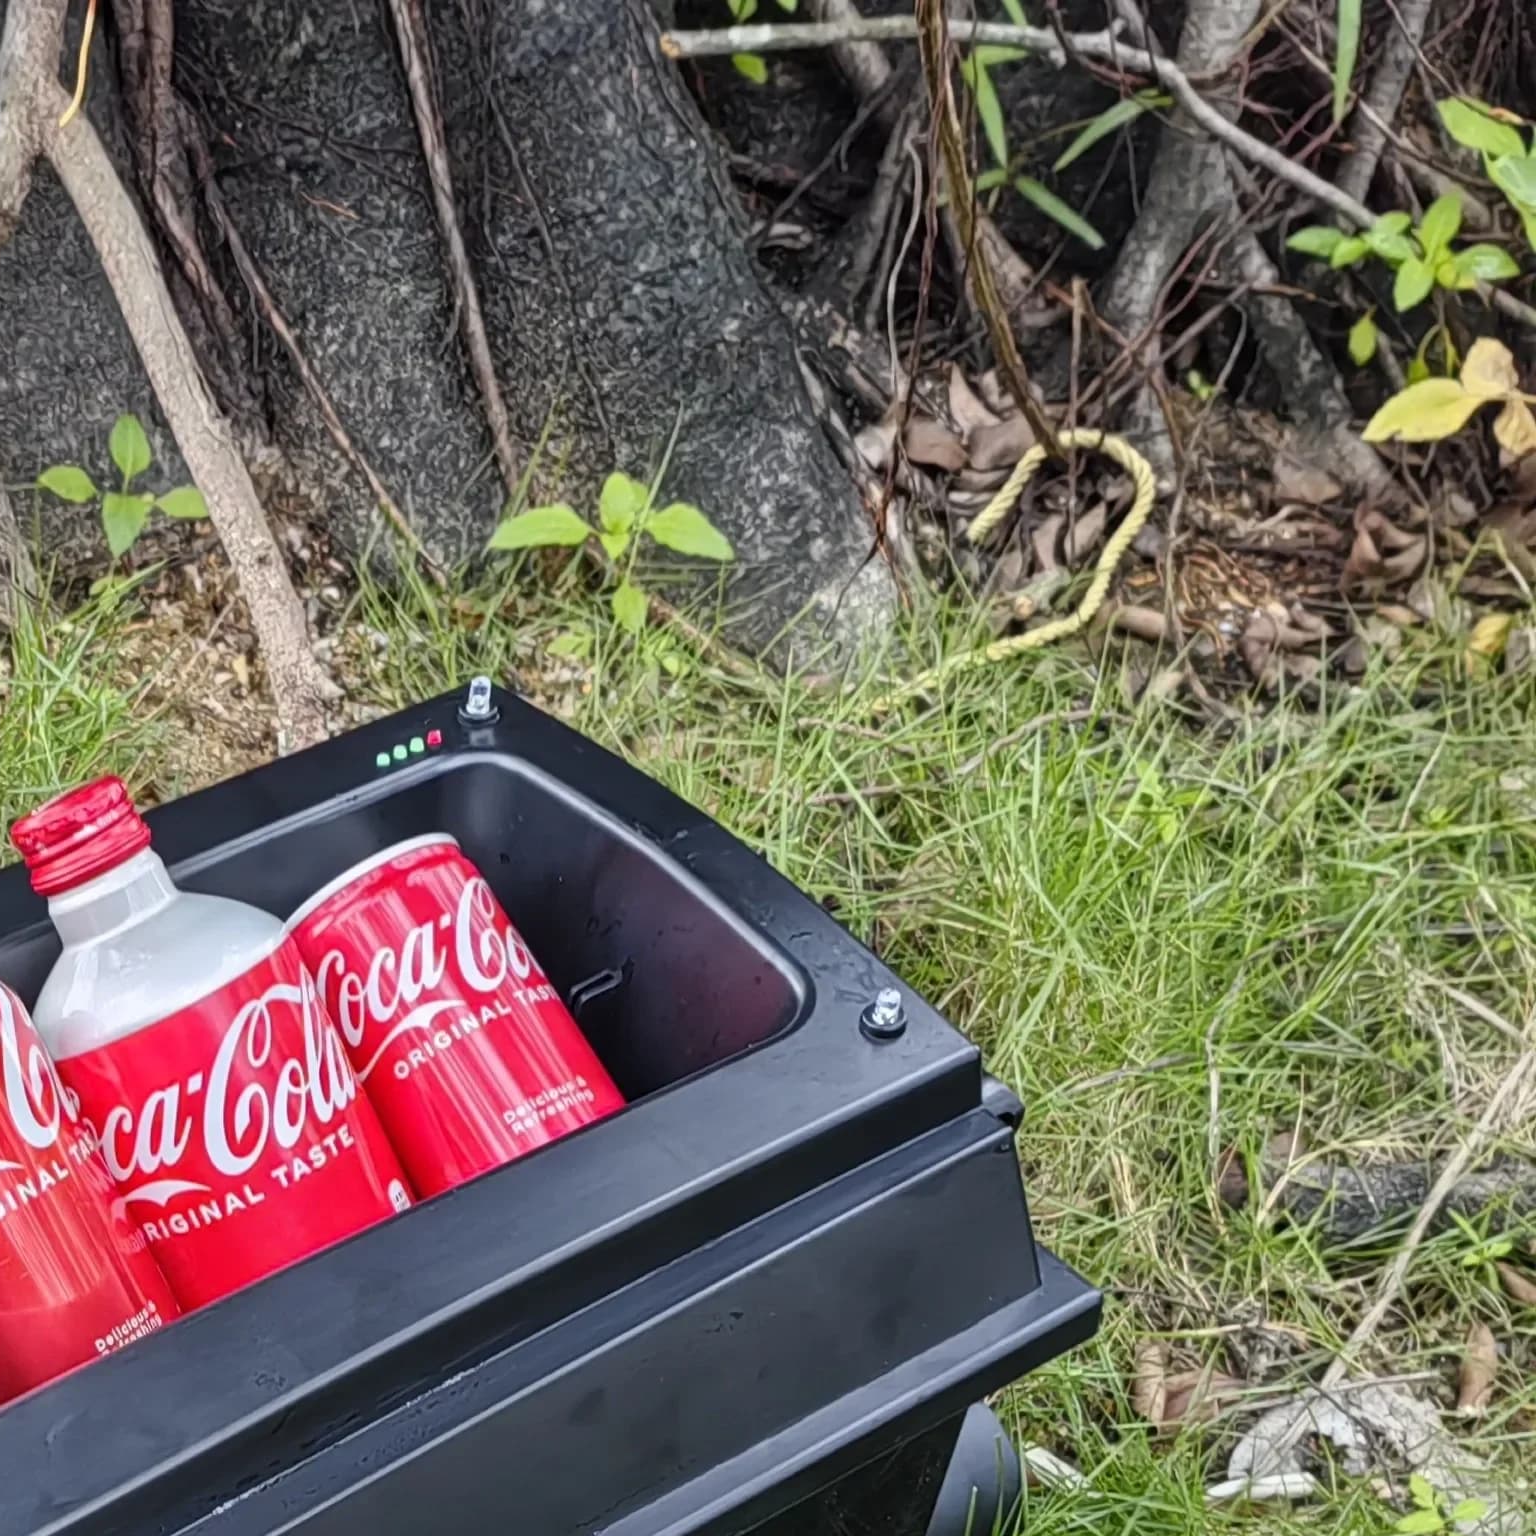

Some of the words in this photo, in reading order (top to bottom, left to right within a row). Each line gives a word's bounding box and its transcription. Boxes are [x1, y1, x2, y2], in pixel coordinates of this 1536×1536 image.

[317, 876, 547, 1081] Coca-Co
[393, 1002, 512, 1080] ORIGINAL
[66, 963, 356, 1207] ca-Cola
[504, 1081, 575, 1125] Delicious
[511, 1088, 595, 1136] Refreshing
[142, 1183, 265, 1243] RIGINAL
[270, 1123, 355, 1189] TASTE
[94, 1307, 149, 1353] Delicious
